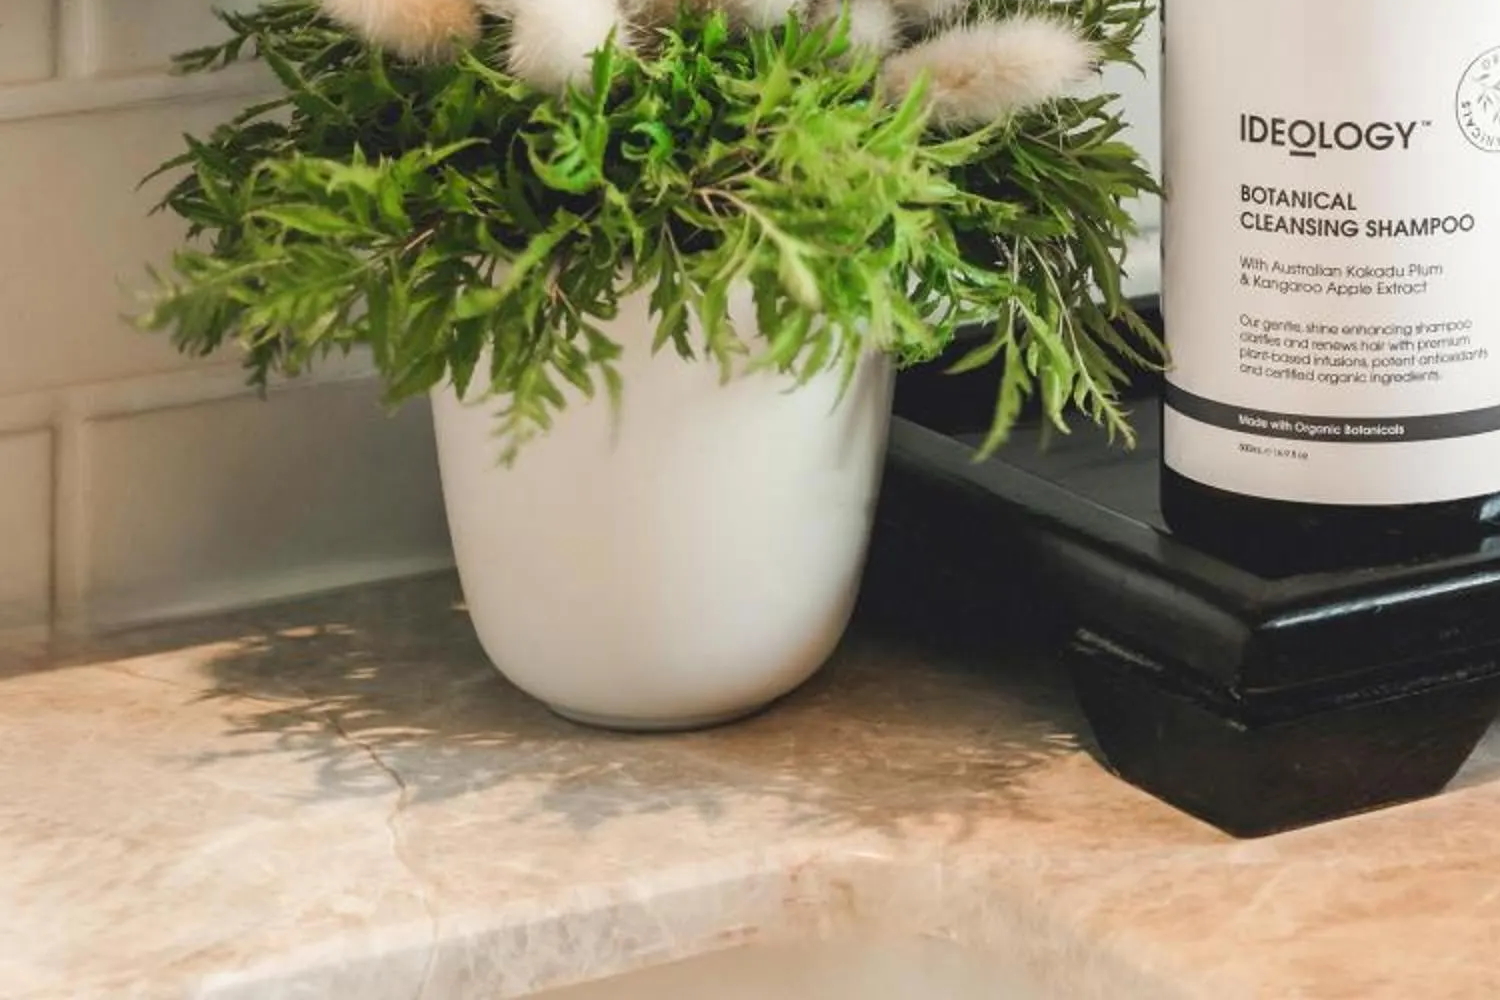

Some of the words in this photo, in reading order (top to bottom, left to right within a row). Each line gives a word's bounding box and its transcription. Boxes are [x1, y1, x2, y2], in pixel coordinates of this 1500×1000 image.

[1240, 184, 1358, 211] BOTANICAL
[1240, 211, 1360, 238] CLEANSING
[1364, 213, 1475, 239] SHAMPOO
[1239, 255, 1269, 271] With
[1272, 261, 1342, 277] Australian
[1346, 264, 1405, 279] Kakadu
[1409, 263, 1443, 277] Plum
[1239, 272, 1250, 286] &
[1253, 275, 1323, 295] Kangaroo
[1326, 281, 1373, 297] Apple
[1377, 281, 1427, 295] Extract
[1239, 313, 1261, 329] Our
[1305, 321, 1339, 335] shine
[1341, 325, 1413, 337] enhancing
[1415, 319, 1473, 335] shampoo
[1283, 338, 1309, 349] and
[1312, 341, 1359, 352] renews
[1361, 340, 1385, 352] hair
[1389, 339, 1415, 352] with
[1417, 335, 1471, 353] premium
[1239, 348, 1310, 365] plant-based
[1371, 354, 1415, 370] potent
[1239, 363, 1263, 377] and
[1264, 367, 1315, 381] certified
[1317, 370, 1367, 386] organic
[1237, 412, 1269, 429] Made
[1270, 418, 1293, 432] with
[1294, 420, 1342, 437] Organic
[1343, 422, 1406, 436] Botanicals
